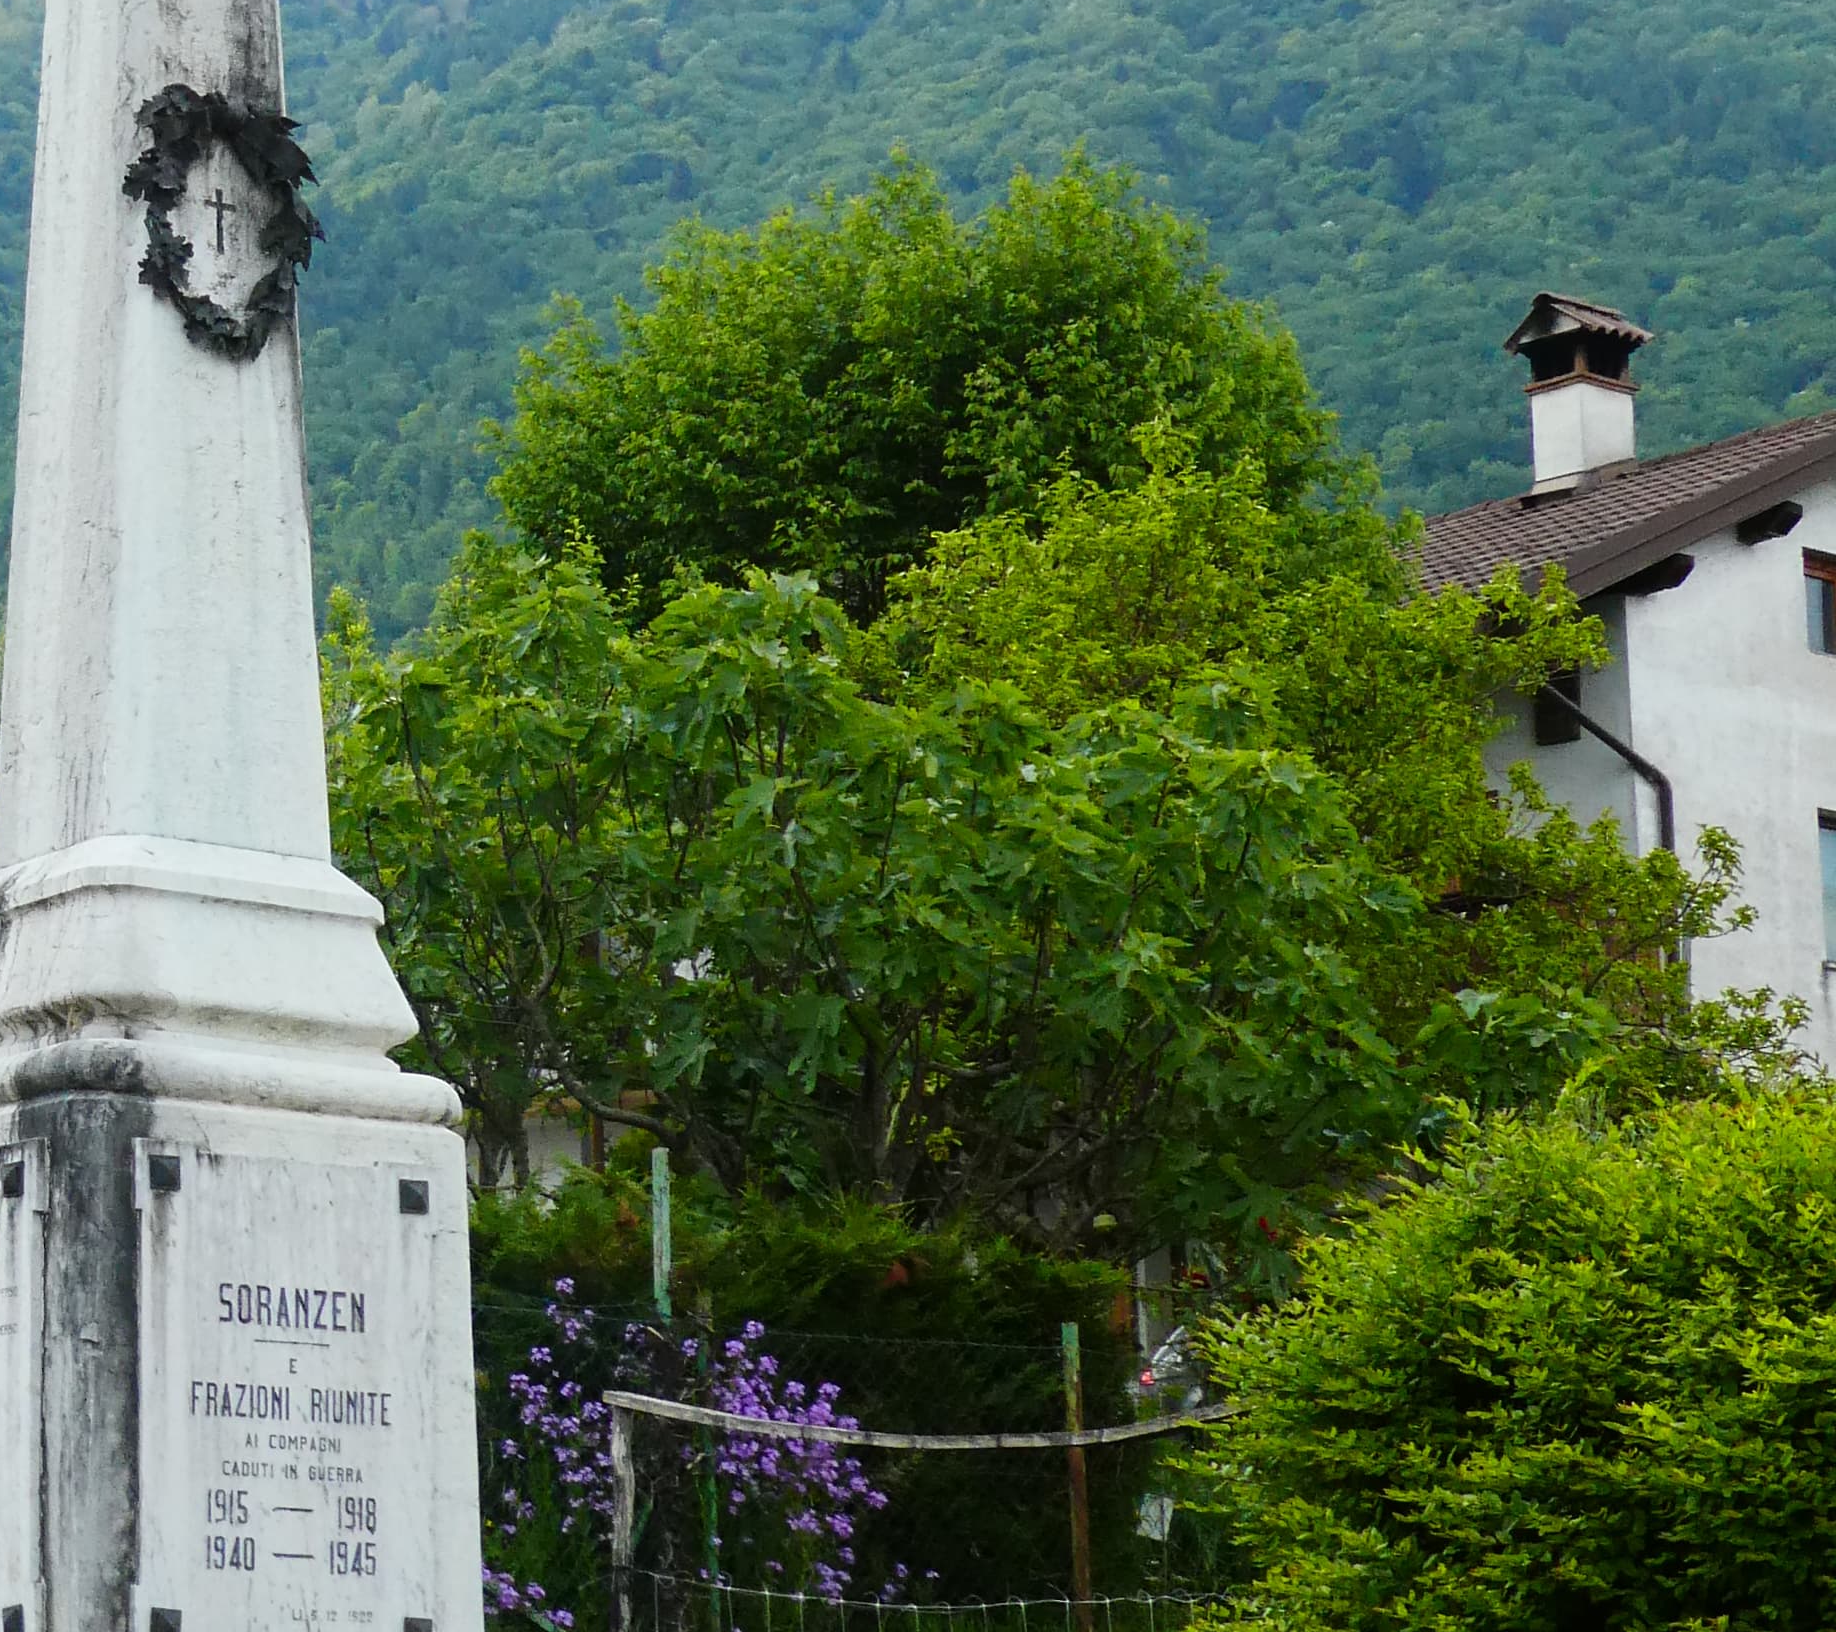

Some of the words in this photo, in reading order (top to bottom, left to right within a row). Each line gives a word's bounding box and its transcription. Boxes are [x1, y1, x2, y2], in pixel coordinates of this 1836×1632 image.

[218, 1282, 366, 1334] SORANZEN
[288, 1357, 298, 1375] E
[191, 1381, 290, 1421] FRAZIONI
[311, 1388, 392, 1427] RIUNITE
[244, 1434, 259, 1449] AI
[268, 1434, 342, 1454] COMPAGNI
[222, 1460, 274, 1479] CADUTI
[283, 1463, 299, 1480] IN
[308, 1465, 364, 1484] GUERRA
[207, 1488, 249, 1525] 1915
[337, 1495, 377, 1534] 1918
[206, 1535, 256, 1572] 1940
[329, 1540, 377, 1577] 1945
